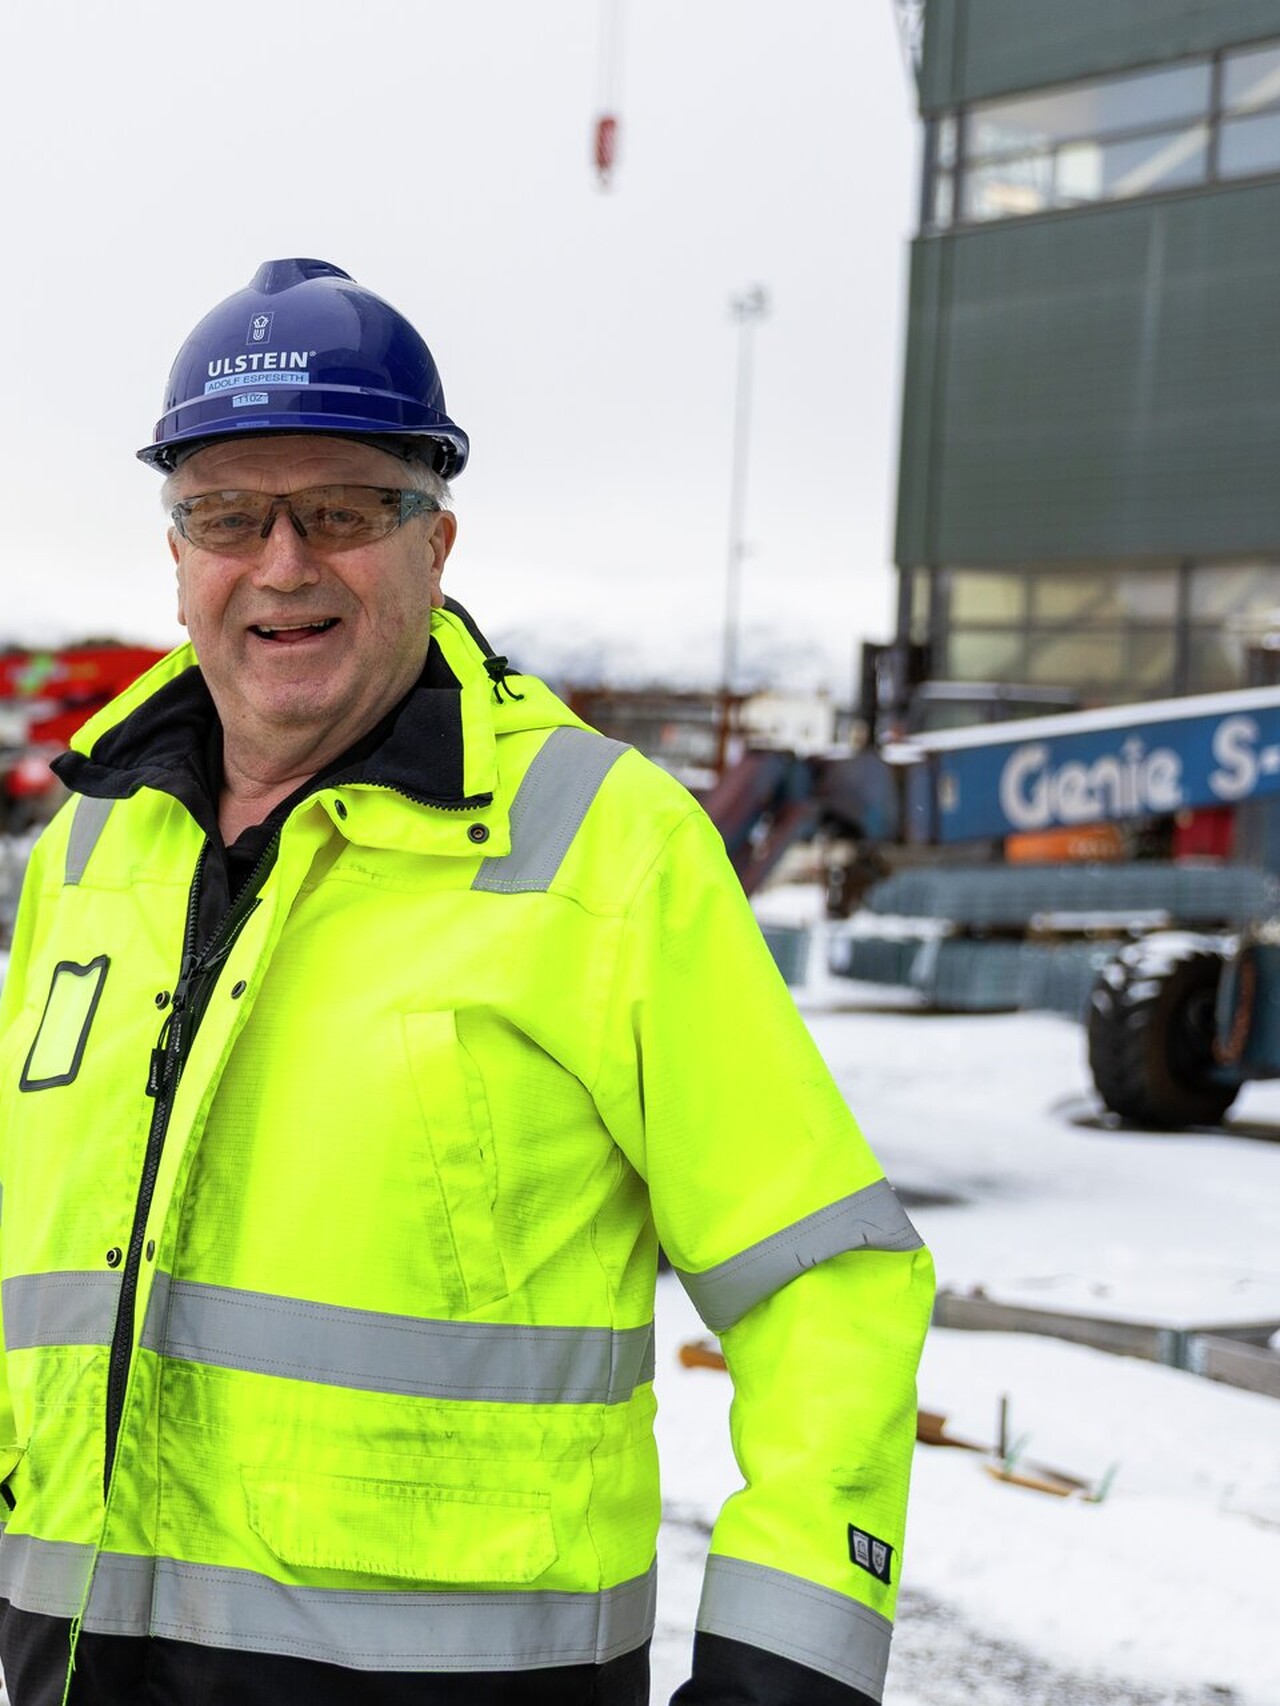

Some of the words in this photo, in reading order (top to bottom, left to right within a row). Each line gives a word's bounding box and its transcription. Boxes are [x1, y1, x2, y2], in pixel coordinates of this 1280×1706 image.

[207, 377, 240, 392] ADOLF
[243, 373, 304, 384] ESPESETH
[1001, 733, 1186, 828] Genie
